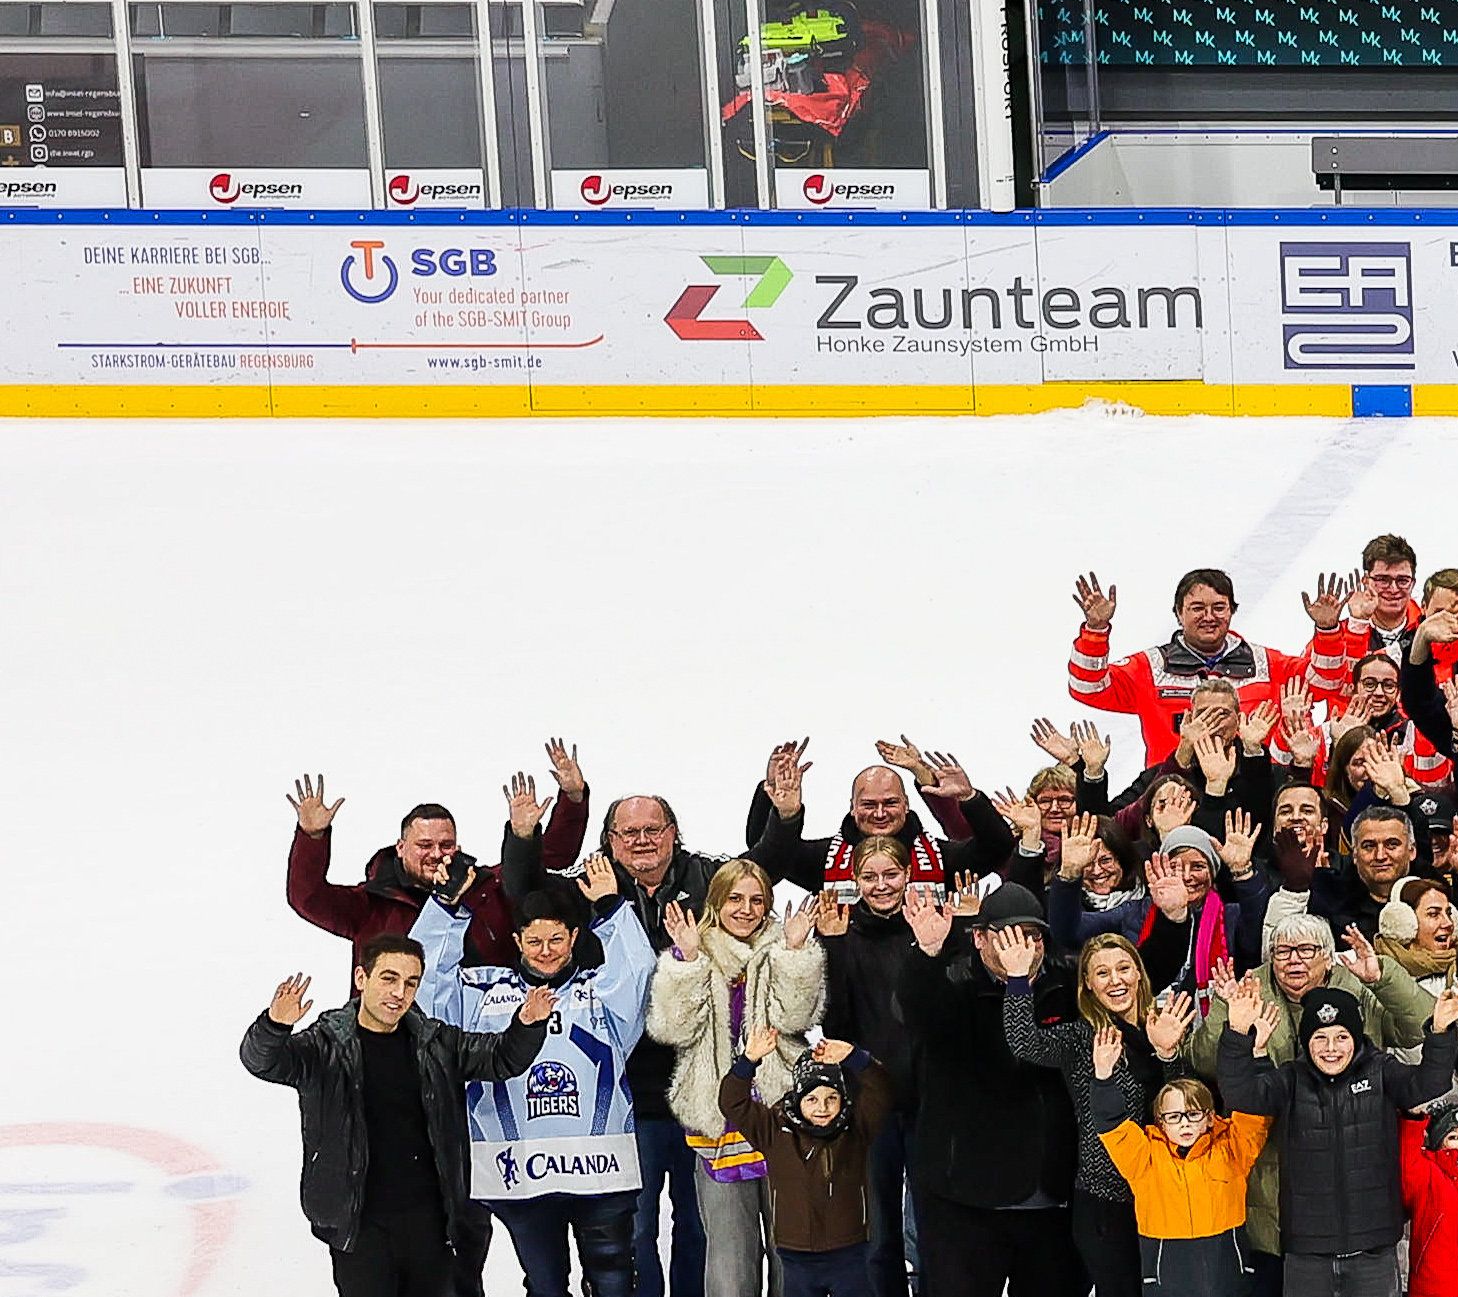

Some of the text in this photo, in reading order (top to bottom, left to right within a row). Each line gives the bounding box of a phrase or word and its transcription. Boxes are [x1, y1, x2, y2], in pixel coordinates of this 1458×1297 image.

[0, 181, 57, 198] epsen
[84, 247, 127, 265] DEINE
[130, 247, 200, 265] KARRIERE
[202, 247, 227, 265] BEI
[411, 248, 498, 277] SGB
[133, 277, 167, 295] EINE
[169, 277, 233, 295] ZUKUNFT
[412, 287, 570, 308] Your dedicated partner
[814, 274, 1204, 330] Zaunteam
[174, 301, 290, 319] VOLLER ENERGIE
[414, 309, 572, 330] of the SGB-SMIT Group
[816, 335, 1100, 358] Honke Zaunsystem GmbH
[91, 351, 315, 370] STARKSTROM-GERÄTEBAU REGENSBURG
[427, 355, 543, 371] www.sgb-smit.de
[527, 1095, 580, 1119] TIGERS
[525, 1153, 620, 1181] CALANDA
